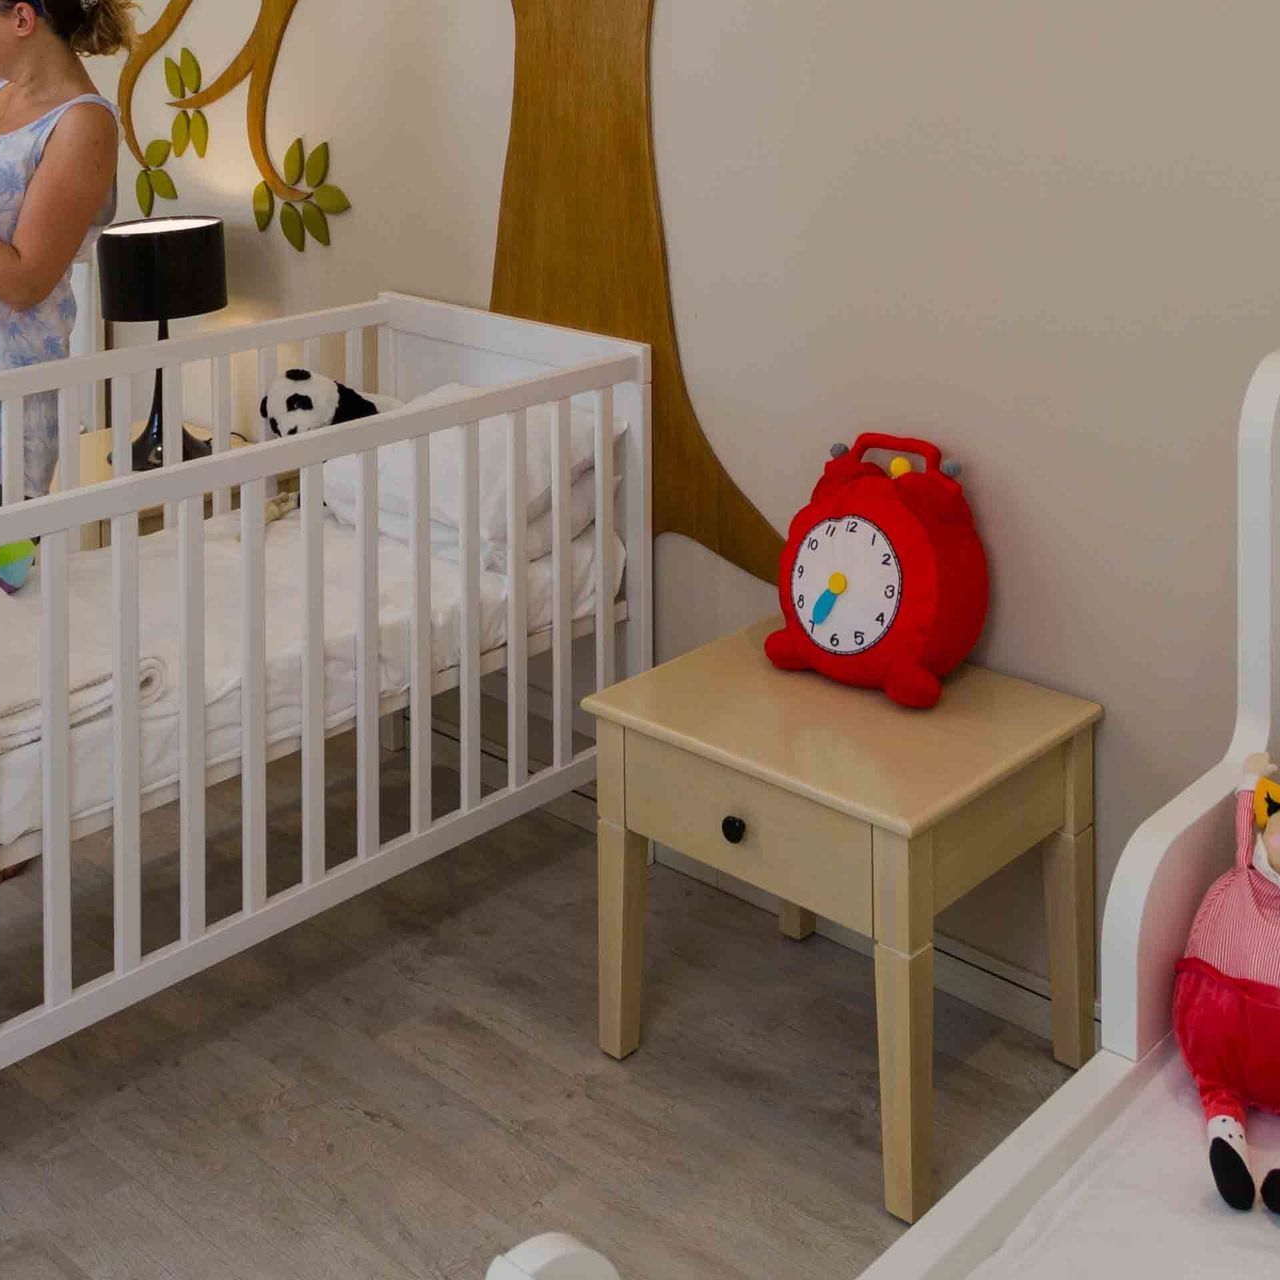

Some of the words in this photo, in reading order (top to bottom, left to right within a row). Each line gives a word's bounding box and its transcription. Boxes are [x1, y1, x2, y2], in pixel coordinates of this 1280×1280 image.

[825, 523, 837, 538] 11
[844, 520, 859, 534] 12
[806, 536, 819, 551] 10
[871, 532, 877, 547] 1
[881, 552, 892, 567] 2
[797, 564, 805, 579] 9
[883, 584, 896, 600] 3
[796, 593, 805, 610] 8
[874, 611, 886, 627] 4
[808, 619, 816, 635] 7
[829, 632, 840, 648] 6
[853, 630, 865, 647] 5
